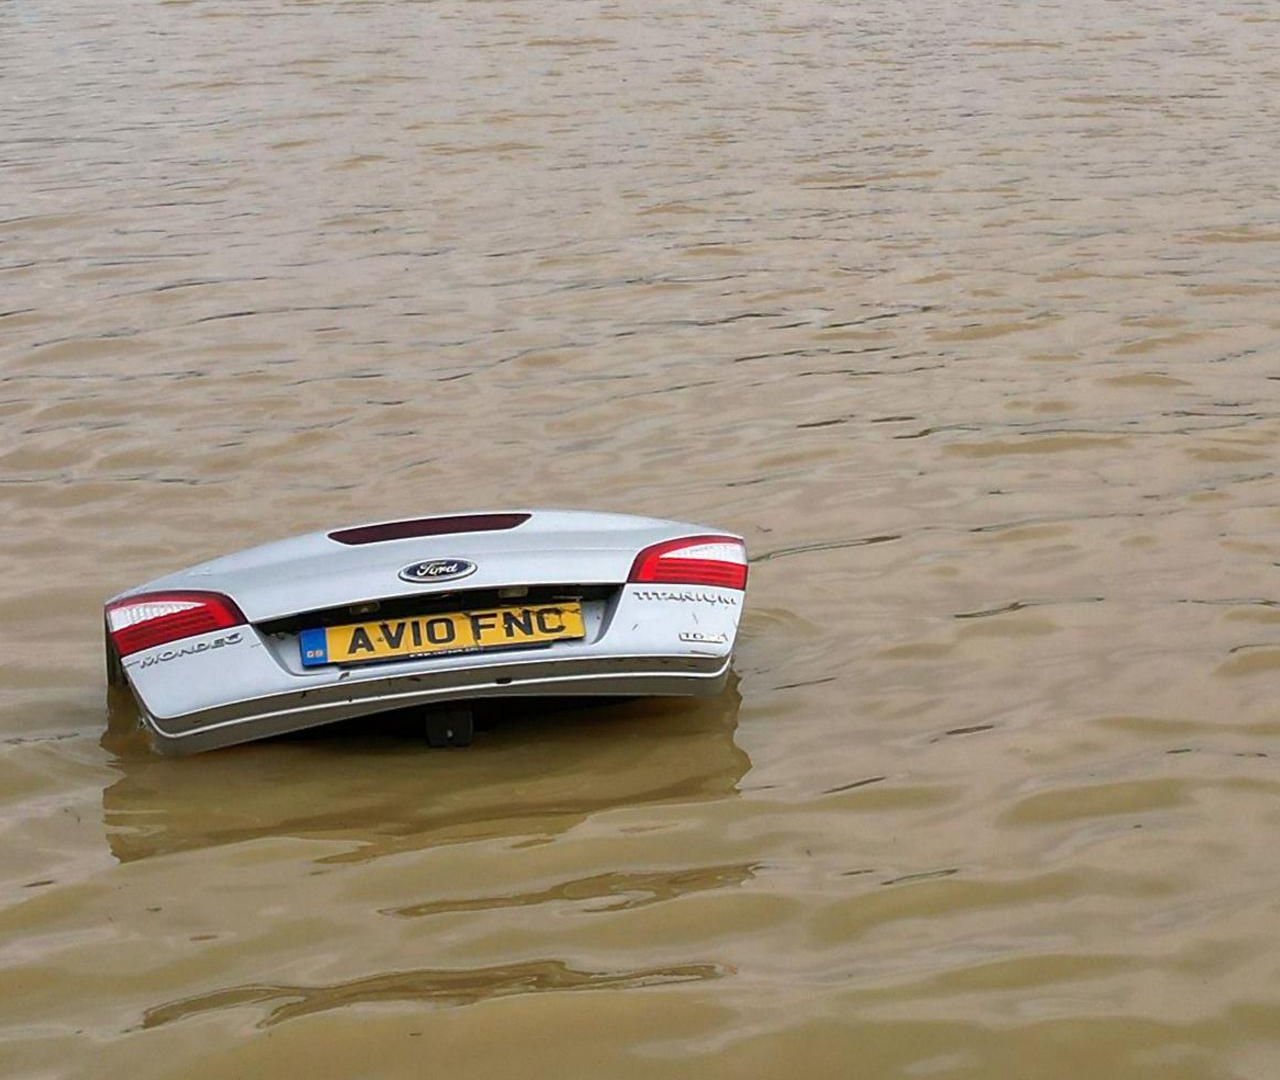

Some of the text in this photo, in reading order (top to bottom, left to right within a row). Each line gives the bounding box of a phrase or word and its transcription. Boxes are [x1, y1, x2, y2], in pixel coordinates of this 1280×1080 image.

[416, 561, 458, 577] Ford
[632, 591, 737, 606] TITANIUM
[347, 607, 566, 655] AV10 FNC
[139, 632, 243, 669] MONDEO
